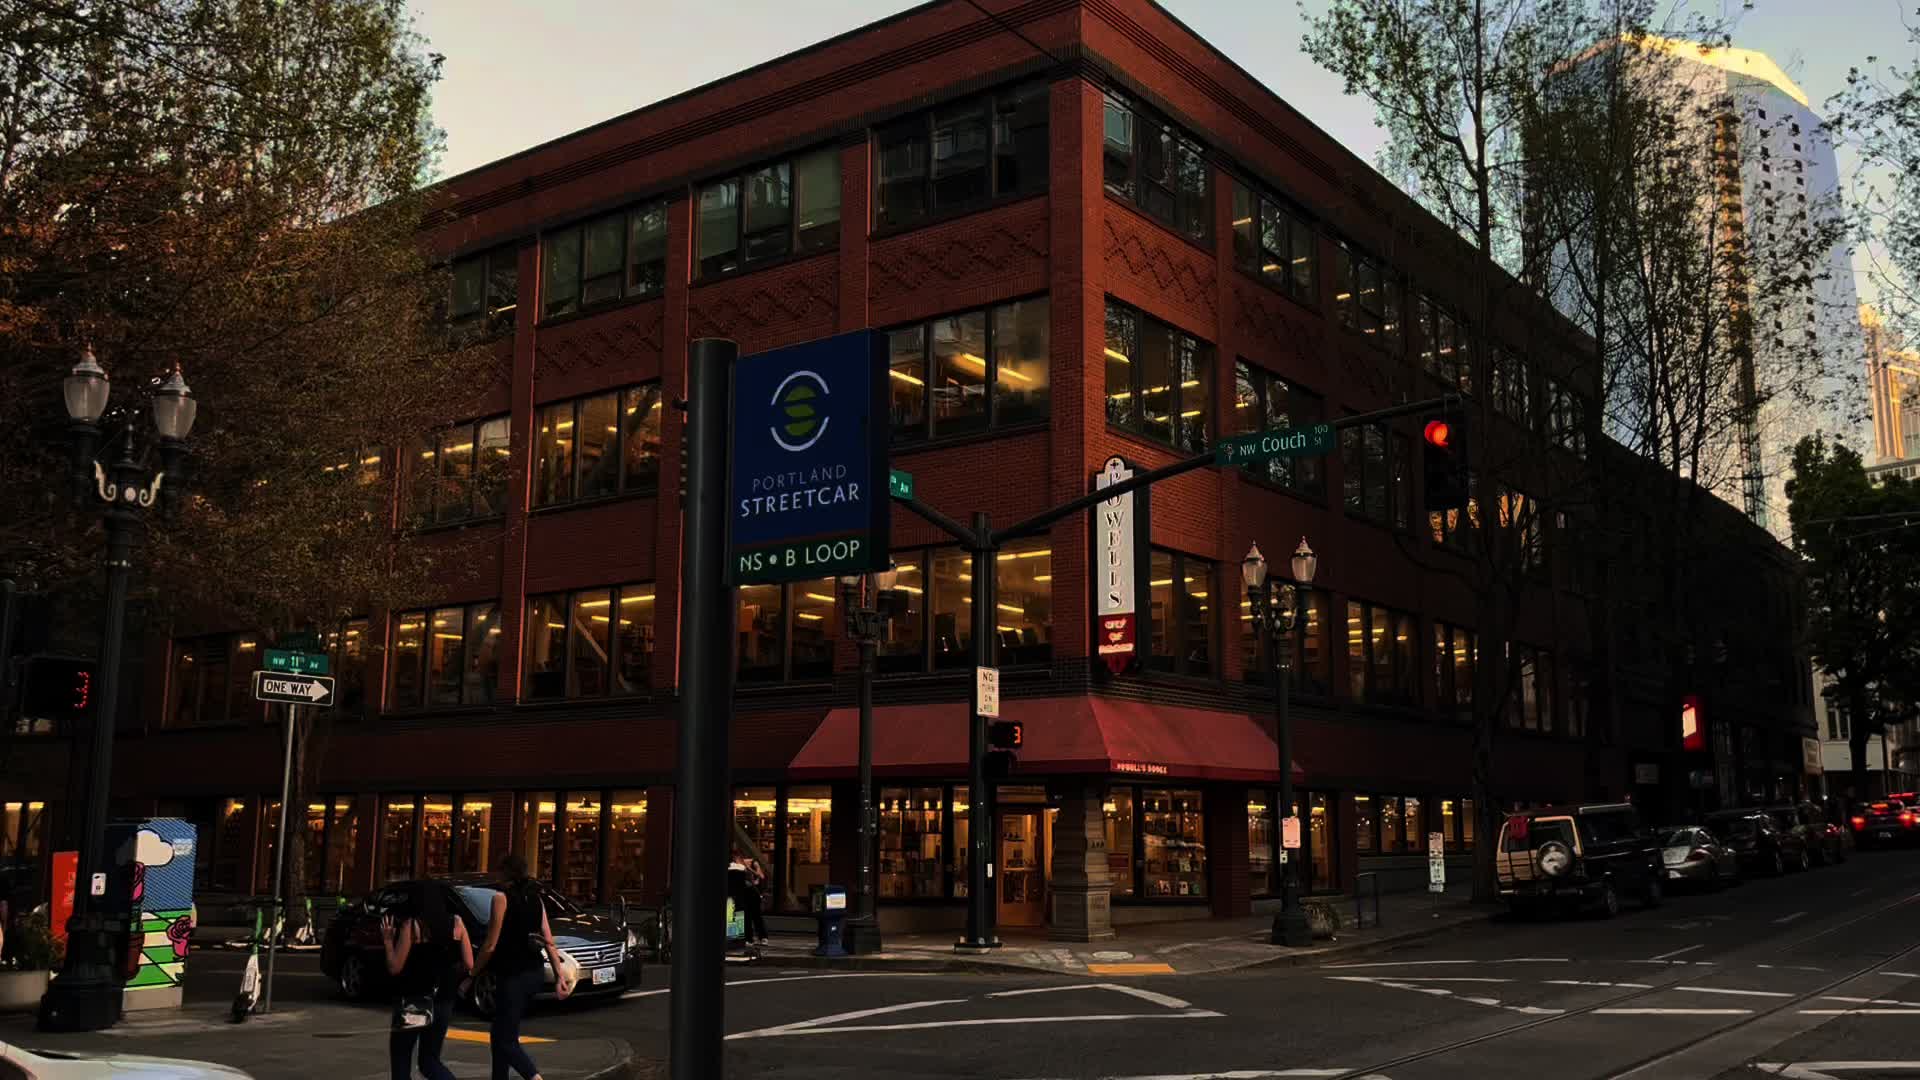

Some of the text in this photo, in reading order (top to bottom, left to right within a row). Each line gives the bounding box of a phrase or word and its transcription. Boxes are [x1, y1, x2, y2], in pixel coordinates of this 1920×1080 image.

[1240, 424, 1329, 457] NW Couch 100
[753, 464, 847, 493] PORTLAND
[740, 482, 860, 518] STREETCAR
[740, 539, 861, 572] NS B LOOP
[75, 671, 90, 711] 3
[265, 680, 313, 696] ONE WAY
[983, 671, 994, 683] NO
[1013, 725, 1022, 745] 3
